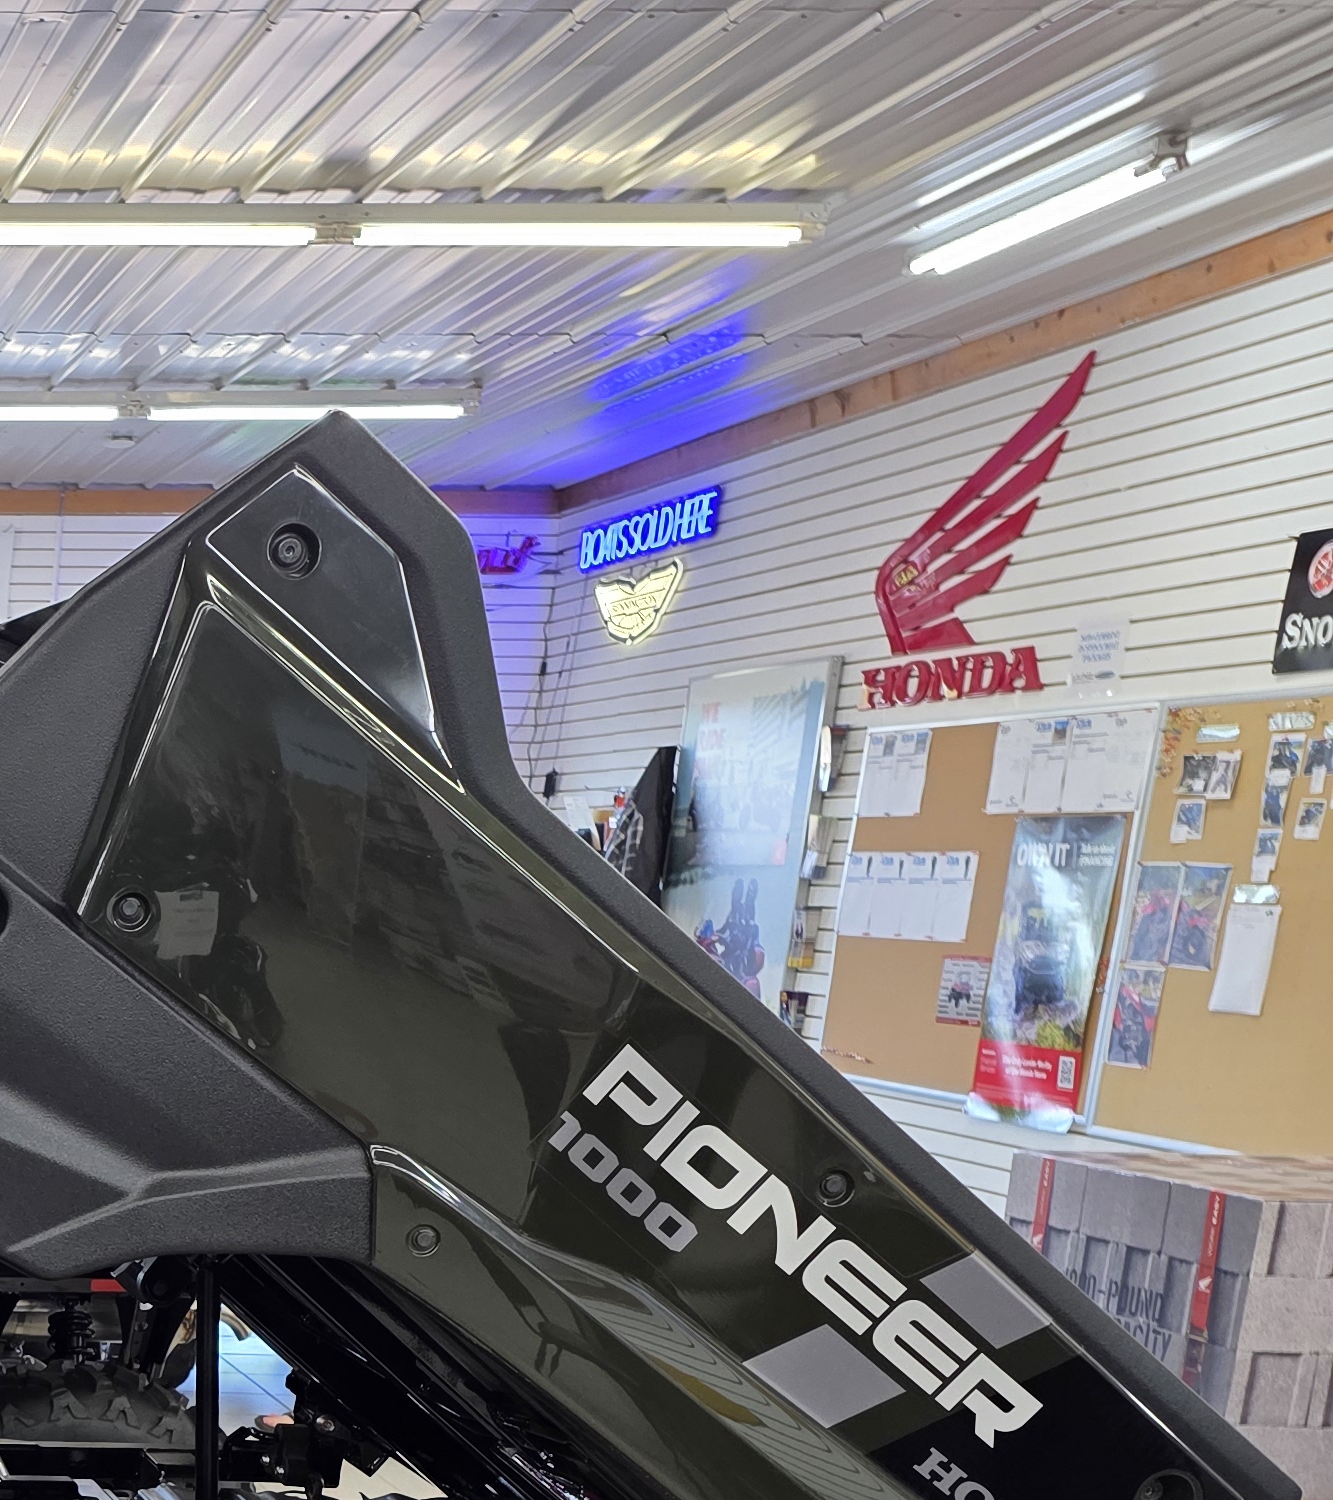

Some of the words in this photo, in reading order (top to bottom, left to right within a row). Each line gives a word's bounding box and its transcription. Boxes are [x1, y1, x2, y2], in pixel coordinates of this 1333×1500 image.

[628, 506, 674, 554] SOLD
[857, 646, 1044, 711] HONDA
[548, 1110, 699, 1253] 1000
[582, 1043, 1043, 1449] PIONEER
